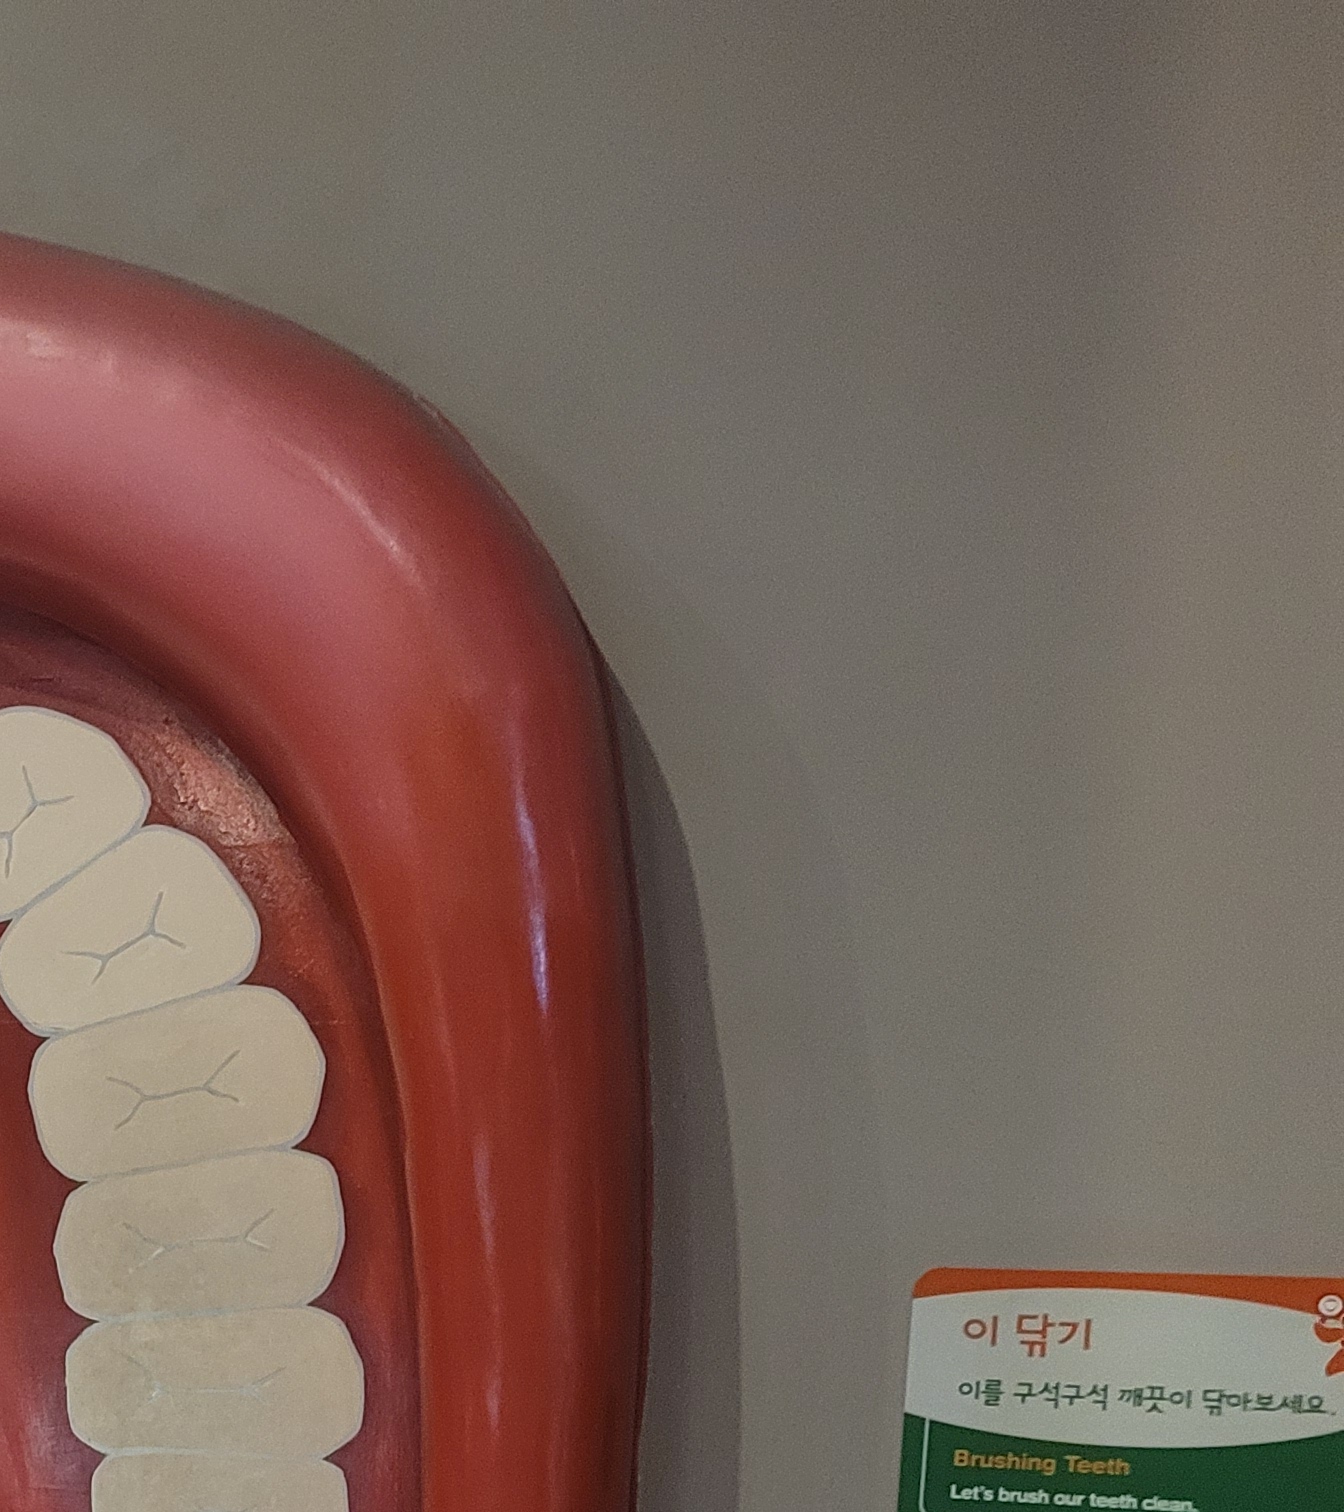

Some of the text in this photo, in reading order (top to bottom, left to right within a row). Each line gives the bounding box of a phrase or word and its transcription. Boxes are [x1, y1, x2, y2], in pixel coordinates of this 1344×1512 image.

[962, 1313, 1093, 1358] 이 닦기
[958, 1379, 1005, 1406] 이를
[1013, 1381, 1109, 1410] 구석구석
[1118, 1386, 1193, 1413] 깨끗이
[953, 1450, 1130, 1476] Brushing Teeth
[949, 1484, 1199, 1512] Let's brush our teeth clean.
